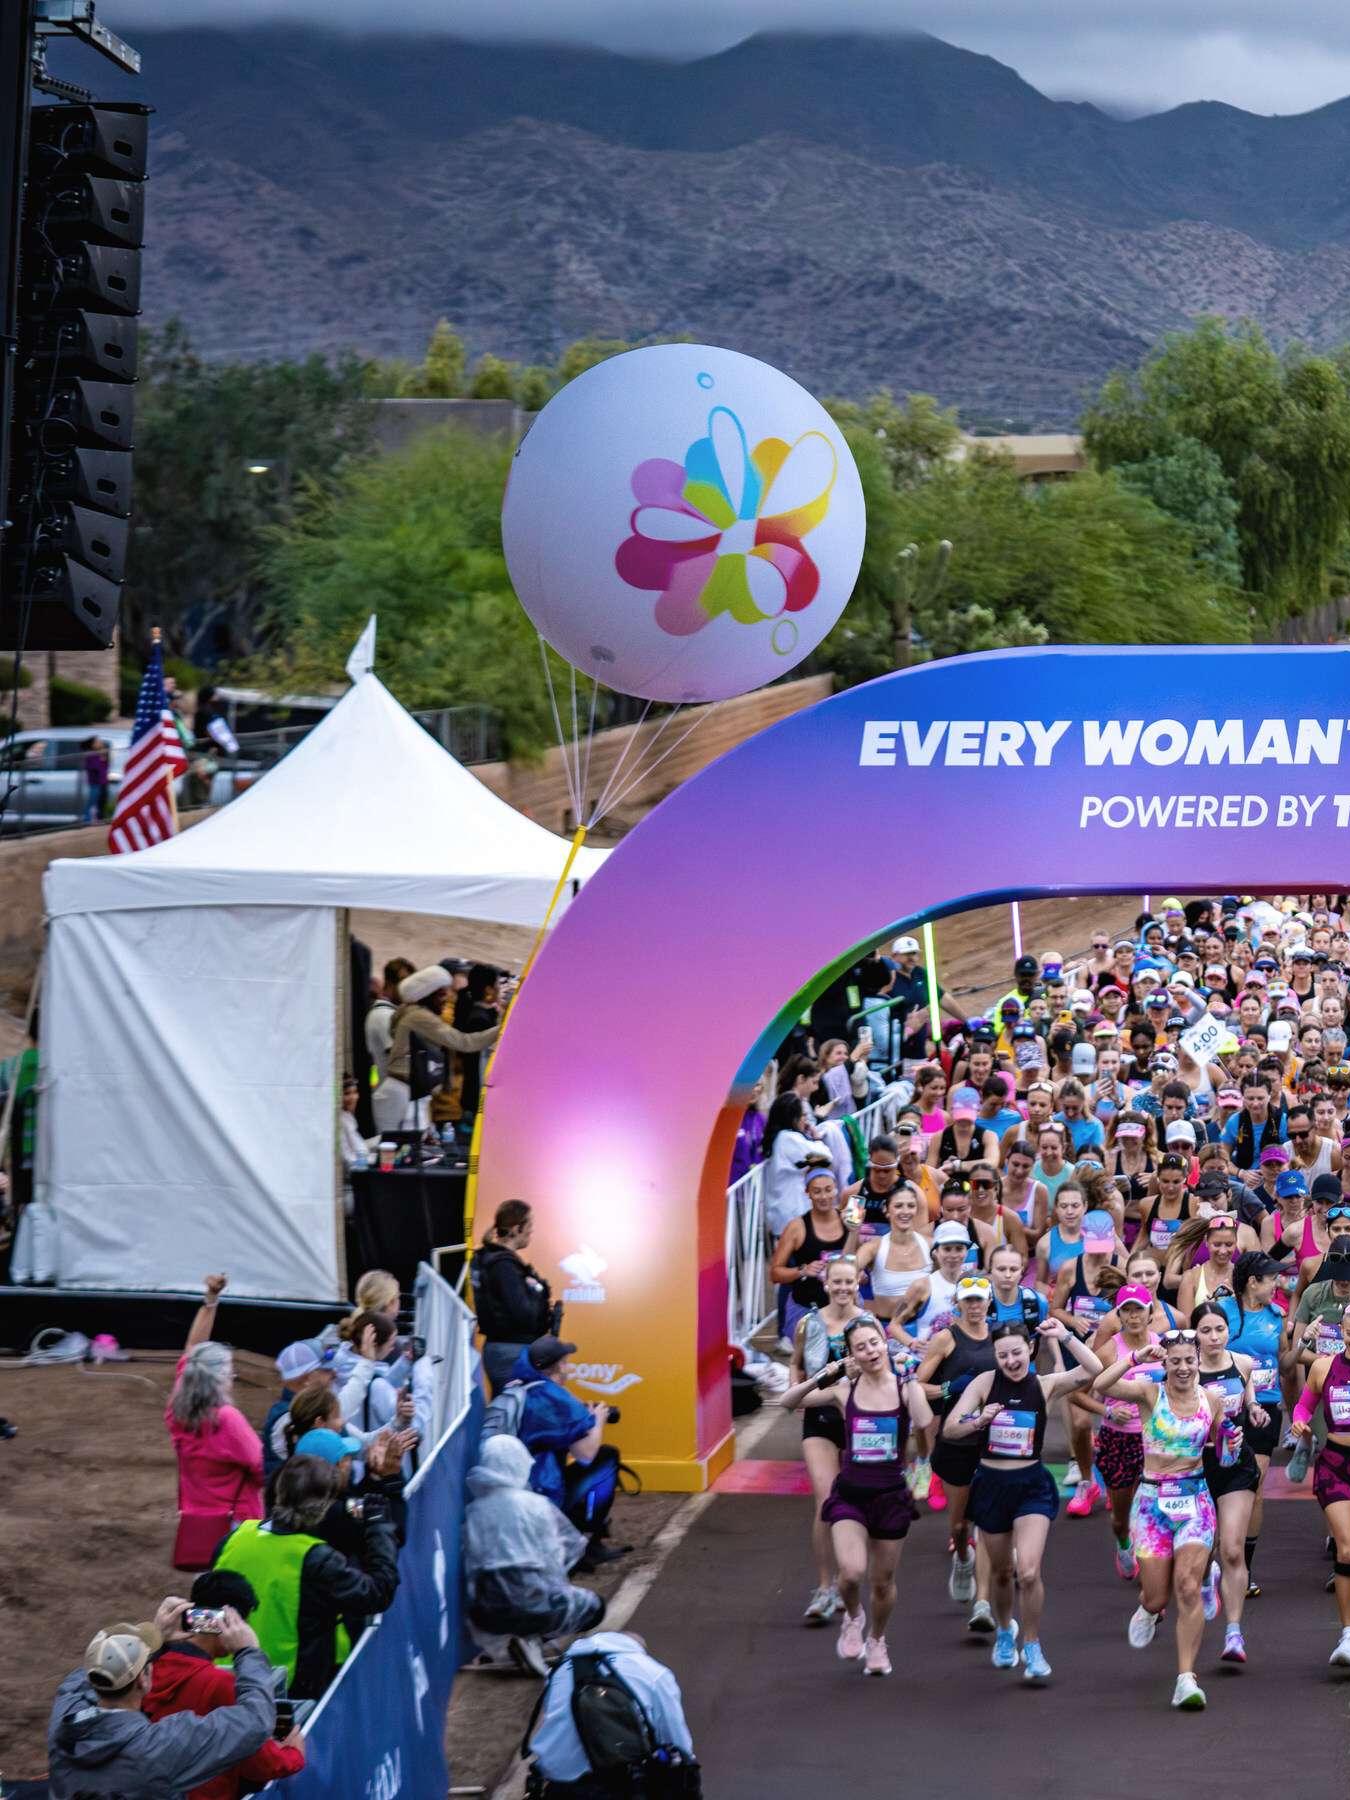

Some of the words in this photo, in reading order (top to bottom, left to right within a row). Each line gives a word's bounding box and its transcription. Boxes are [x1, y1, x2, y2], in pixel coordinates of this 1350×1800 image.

[858, 720, 1073, 767] EVERY
[1079, 795, 1269, 829] POWERED
[1276, 795, 1326, 828] BY
[1193, 1025, 1218, 1053] 4:00
[566, 1362, 618, 1382] cony
[996, 1429, 1022, 1439] 3586
[1164, 1499, 1190, 1510] 4605
